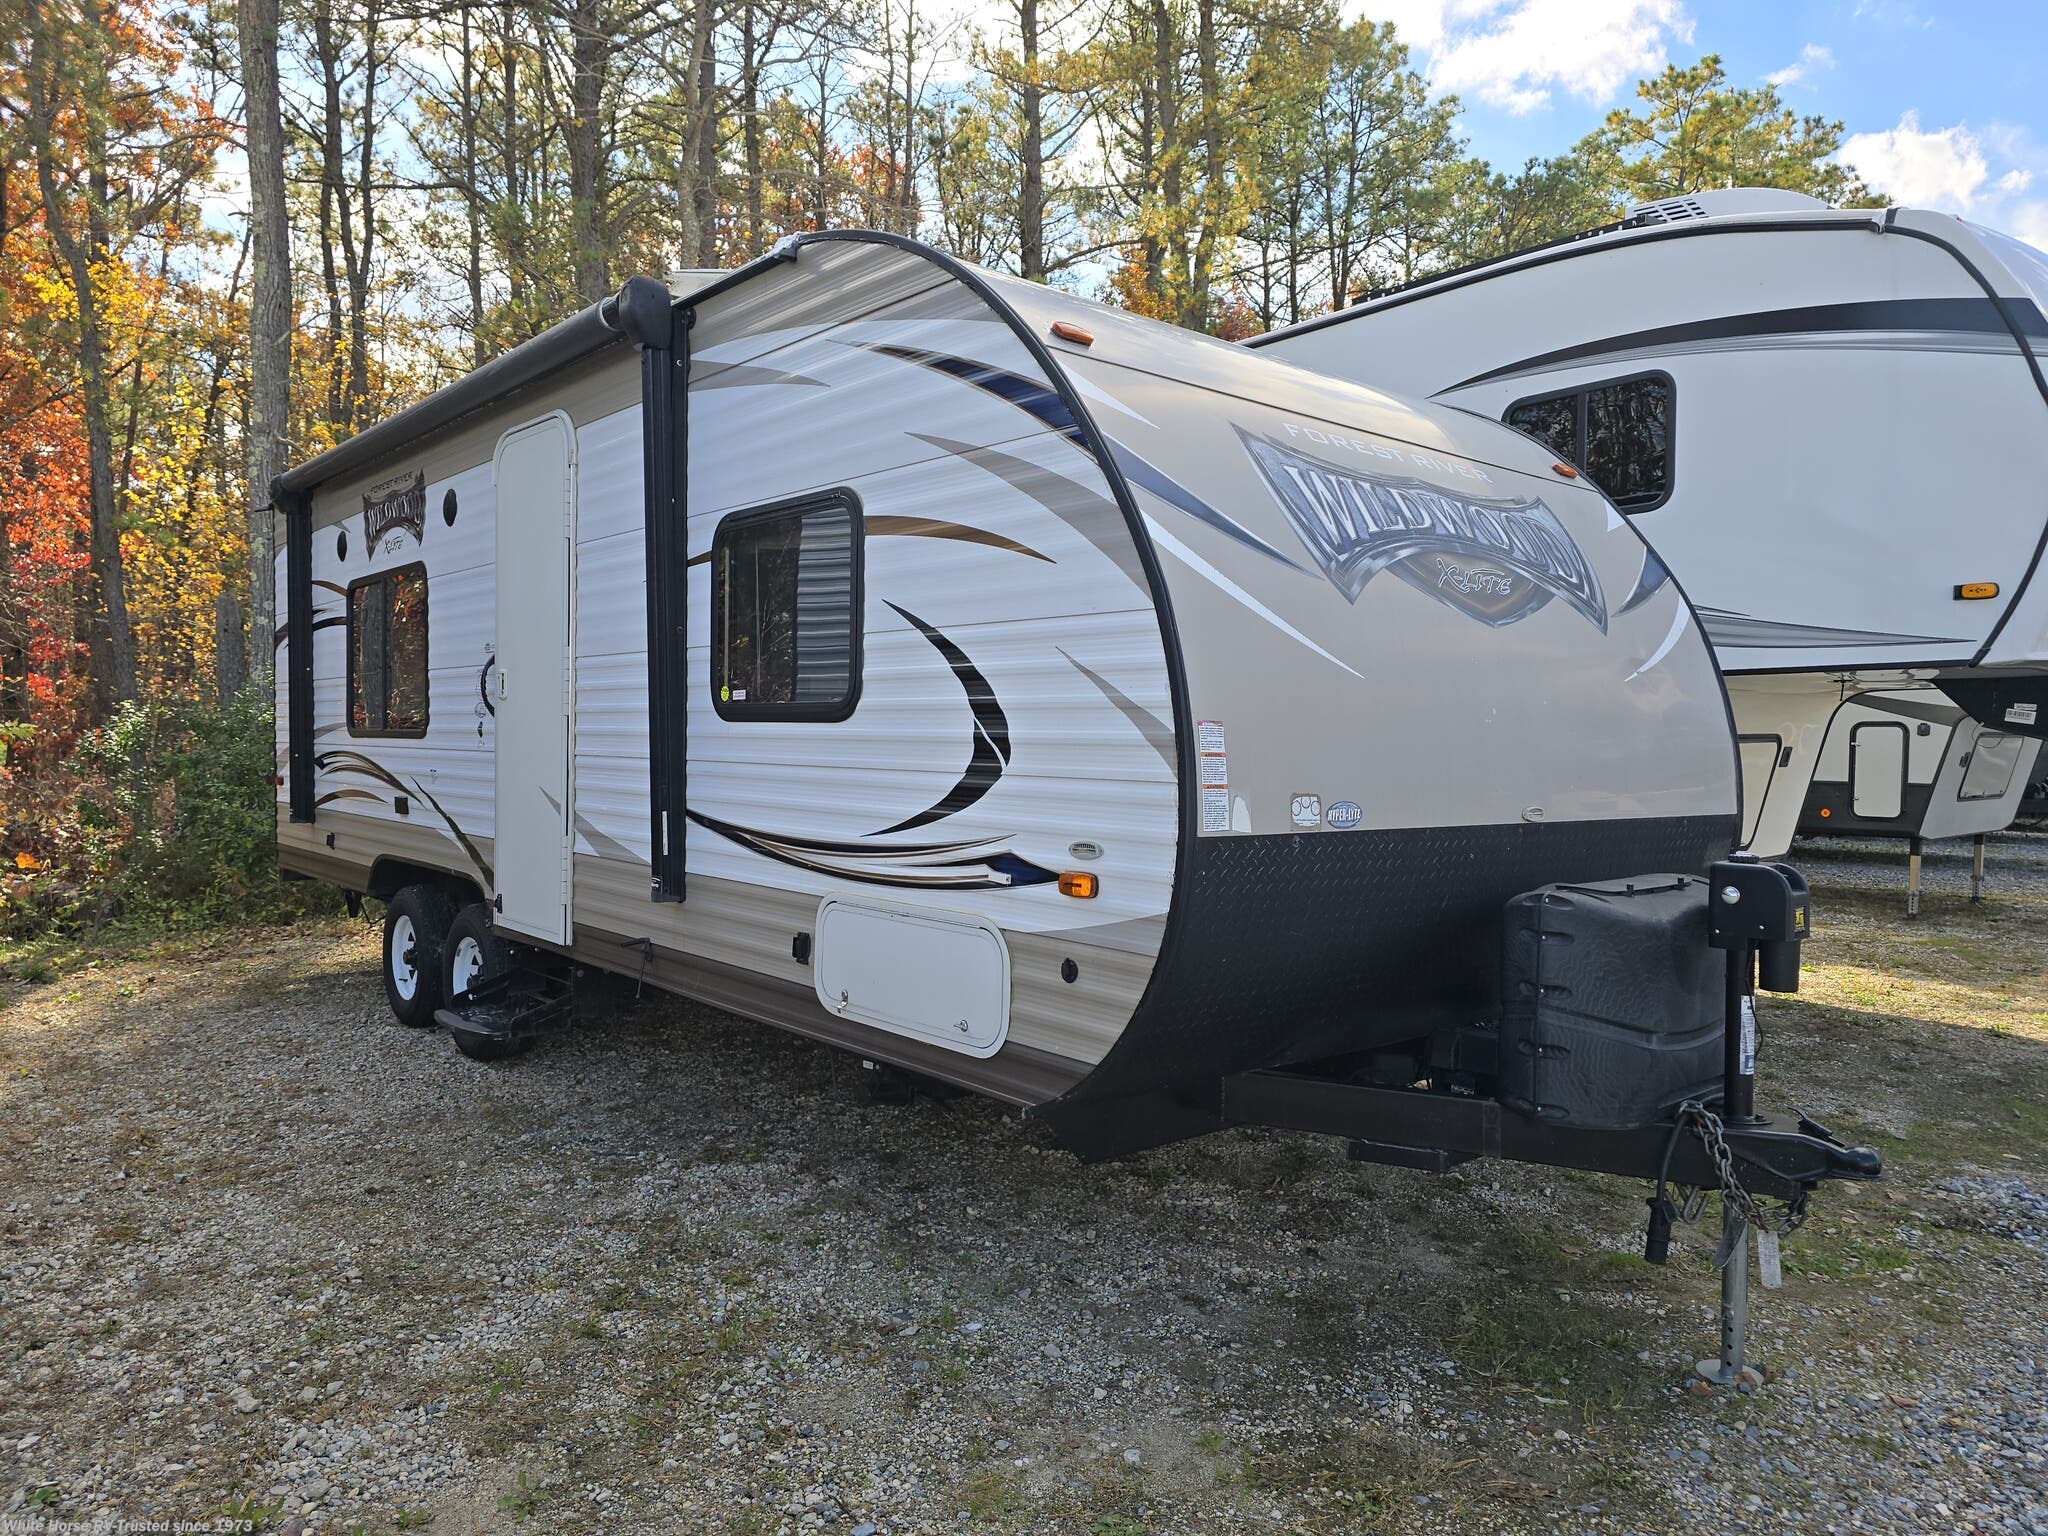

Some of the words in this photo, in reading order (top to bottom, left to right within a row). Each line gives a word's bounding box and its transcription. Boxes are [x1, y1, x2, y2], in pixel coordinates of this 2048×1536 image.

[1282, 423, 1405, 463] FOREST
[1410, 454, 1494, 484] RIVER
[1283, 464, 1579, 584] WILDWOOD
[1327, 808, 1361, 822] HYPER-LYTE
